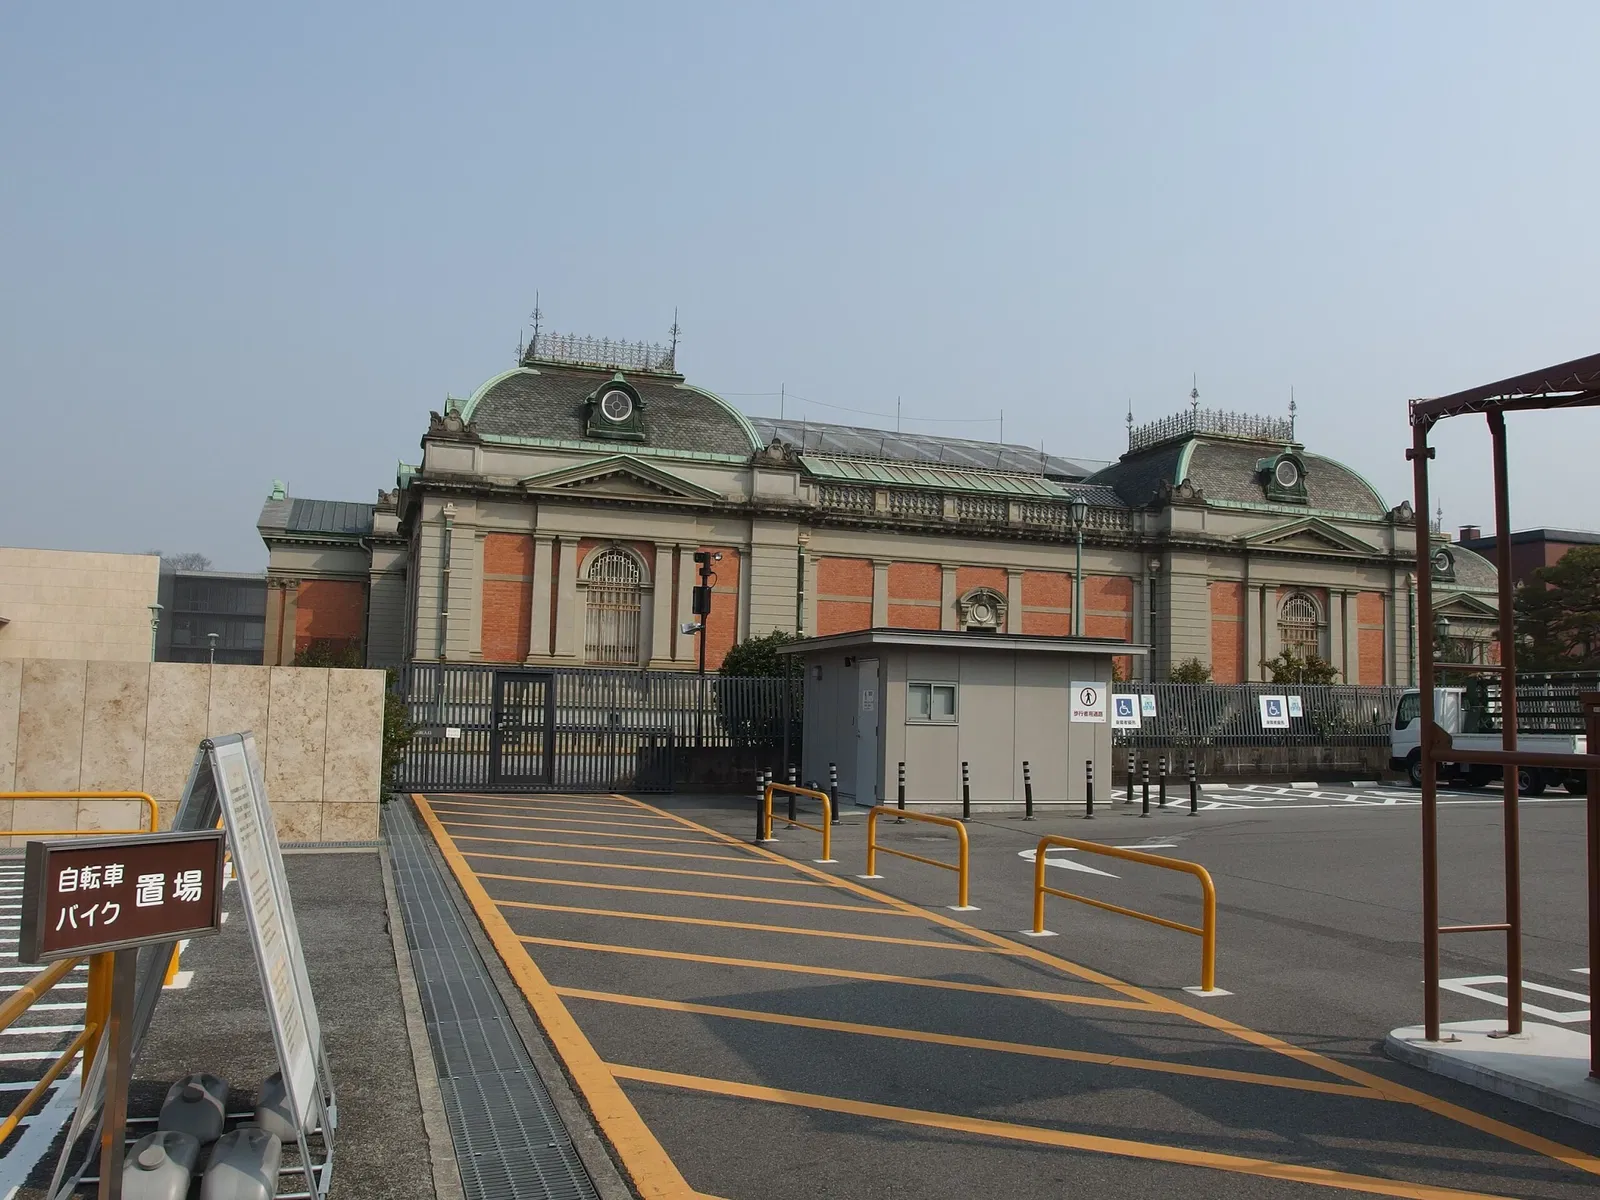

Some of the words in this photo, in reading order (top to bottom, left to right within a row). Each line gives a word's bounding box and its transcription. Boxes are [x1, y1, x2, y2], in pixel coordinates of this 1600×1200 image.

[58, 863, 125, 893] 自転車
[136, 870, 203, 907] 置場
[55, 901, 121, 931] バイク
